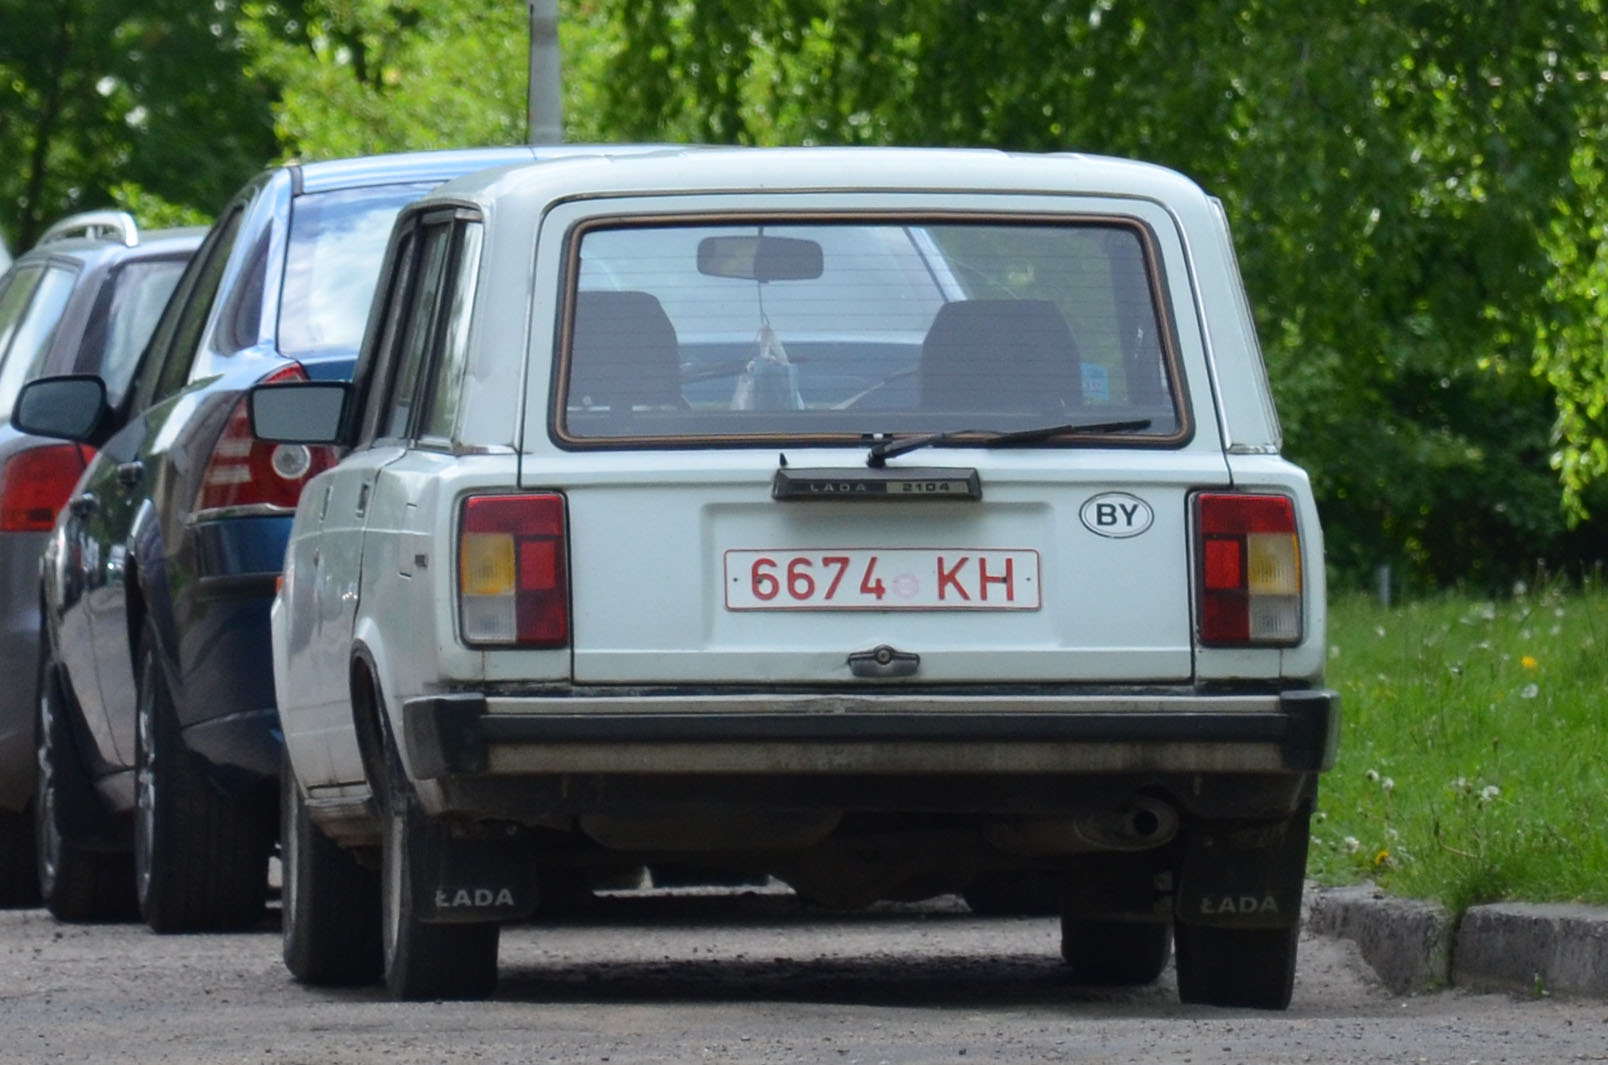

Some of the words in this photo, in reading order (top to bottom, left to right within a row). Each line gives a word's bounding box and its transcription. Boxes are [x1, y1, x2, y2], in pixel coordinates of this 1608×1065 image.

[809, 483, 867, 493] LADA
[902, 482, 950, 491] 2104
[1096, 503, 1138, 526] BY
[751, 557, 886, 601] 6674
[937, 556, 1014, 601] KH
